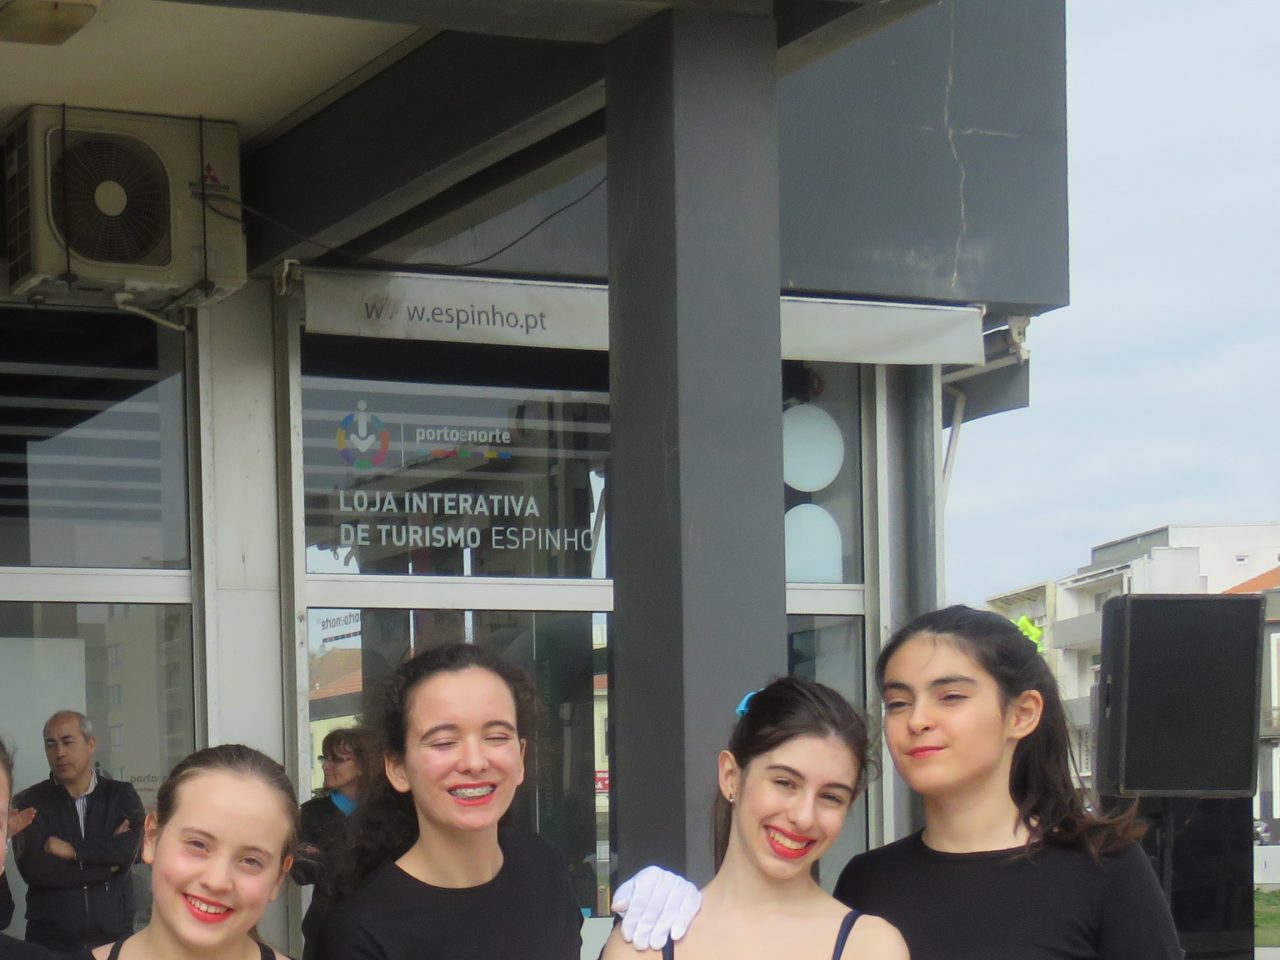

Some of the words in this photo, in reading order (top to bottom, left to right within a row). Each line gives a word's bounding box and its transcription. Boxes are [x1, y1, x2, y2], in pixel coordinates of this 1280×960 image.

[364, 302, 547, 334] ww.espinho.pt
[339, 491, 398, 513] LOJA
[405, 492, 540, 517] INTERATIVA
[340, 523, 370, 546] DE
[377, 525, 481, 549] TURISMO
[492, 526, 594, 551] ESPINHO
